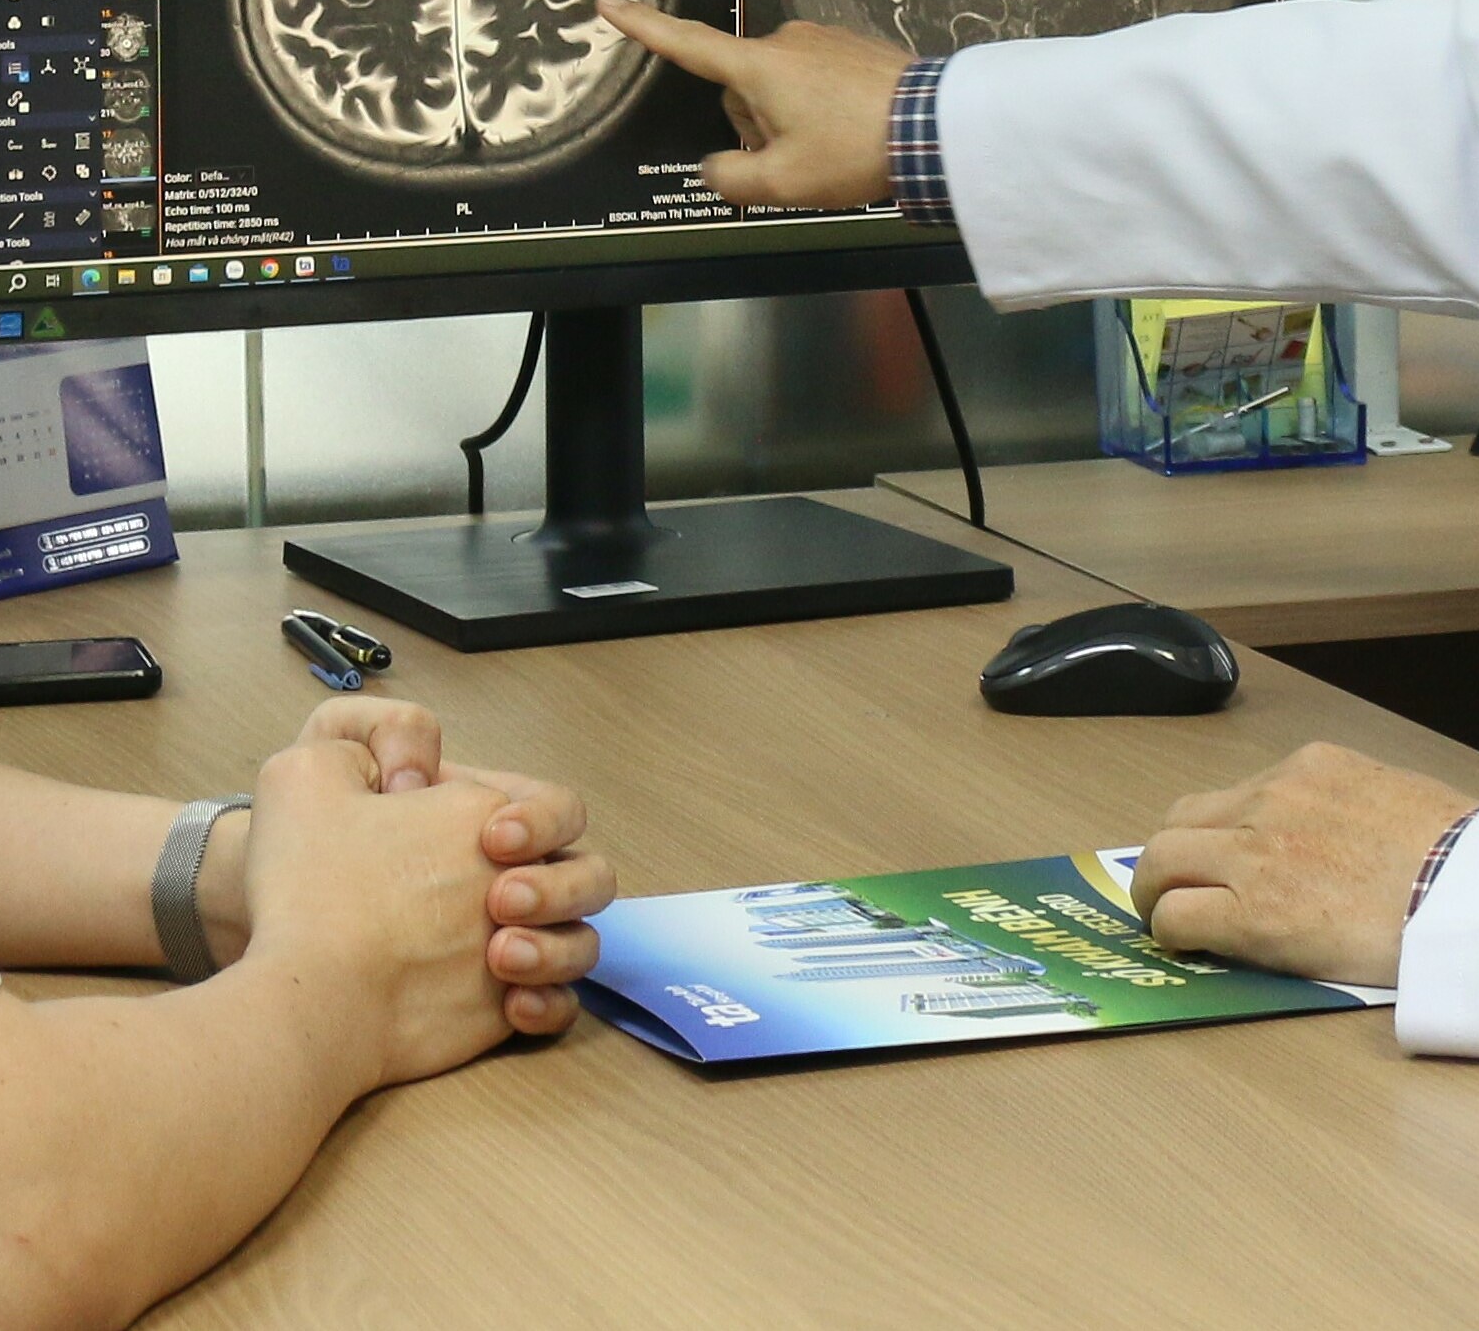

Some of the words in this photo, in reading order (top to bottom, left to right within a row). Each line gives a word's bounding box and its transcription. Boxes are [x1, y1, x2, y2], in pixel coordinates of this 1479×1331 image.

[638, 164, 660, 175] Slice
[164, 172, 192, 183] Color:
[20, 191, 43, 202] Tools
[164, 189, 196, 201] Matrix:
[198, 186, 258, 199] 0/512/324/0
[165, 206, 188, 217] Echo
[190, 204, 213, 215] time:
[216, 204, 233, 214] 100
[234, 204, 250, 213] ms
[456, 202, 473, 215] PL
[684, 207, 711, 218] Thanh
[165, 220, 212, 234] Repetition
[238, 218, 262, 229] 2850
[264, 218, 279, 227] ms
[7, 238, 30, 248] Tools
[166, 237, 185, 248] Hoa
[1037, 893, 1138, 937] RECORD
